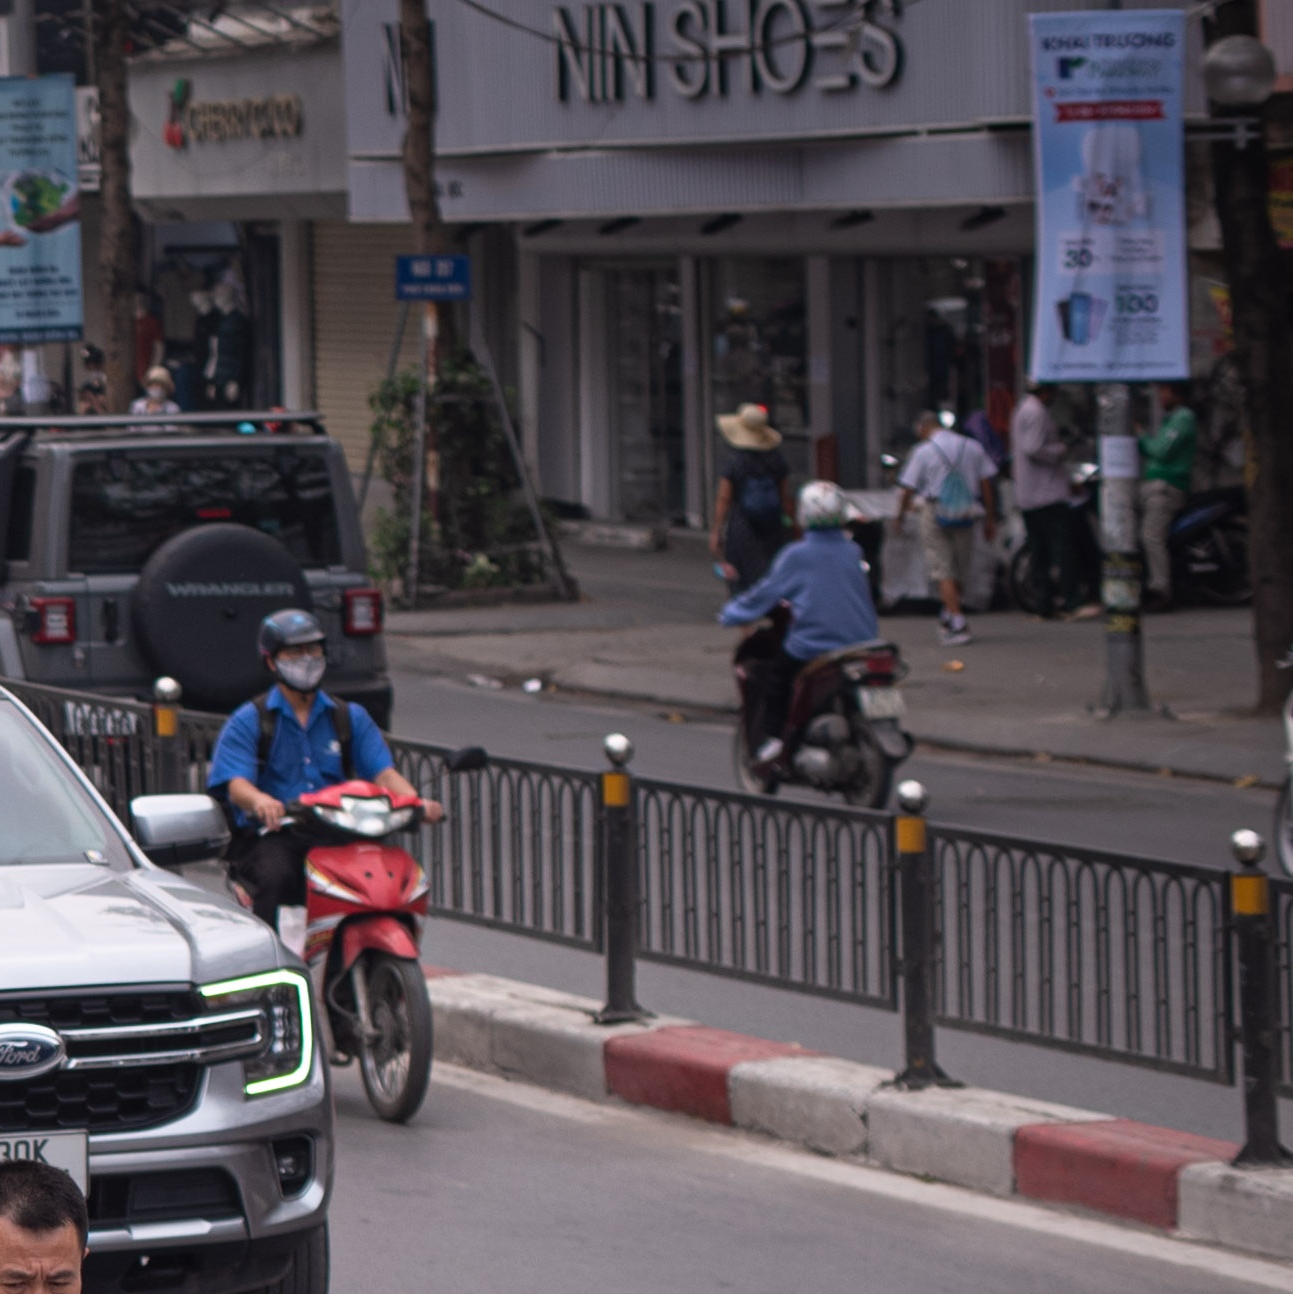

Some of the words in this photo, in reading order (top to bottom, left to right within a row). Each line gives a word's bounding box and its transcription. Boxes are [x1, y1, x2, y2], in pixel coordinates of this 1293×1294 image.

[553, 3, 655, 101] NIN
[670, 0, 904, 98] SHOES
[166, 581, 295, 597] WRANGLER
